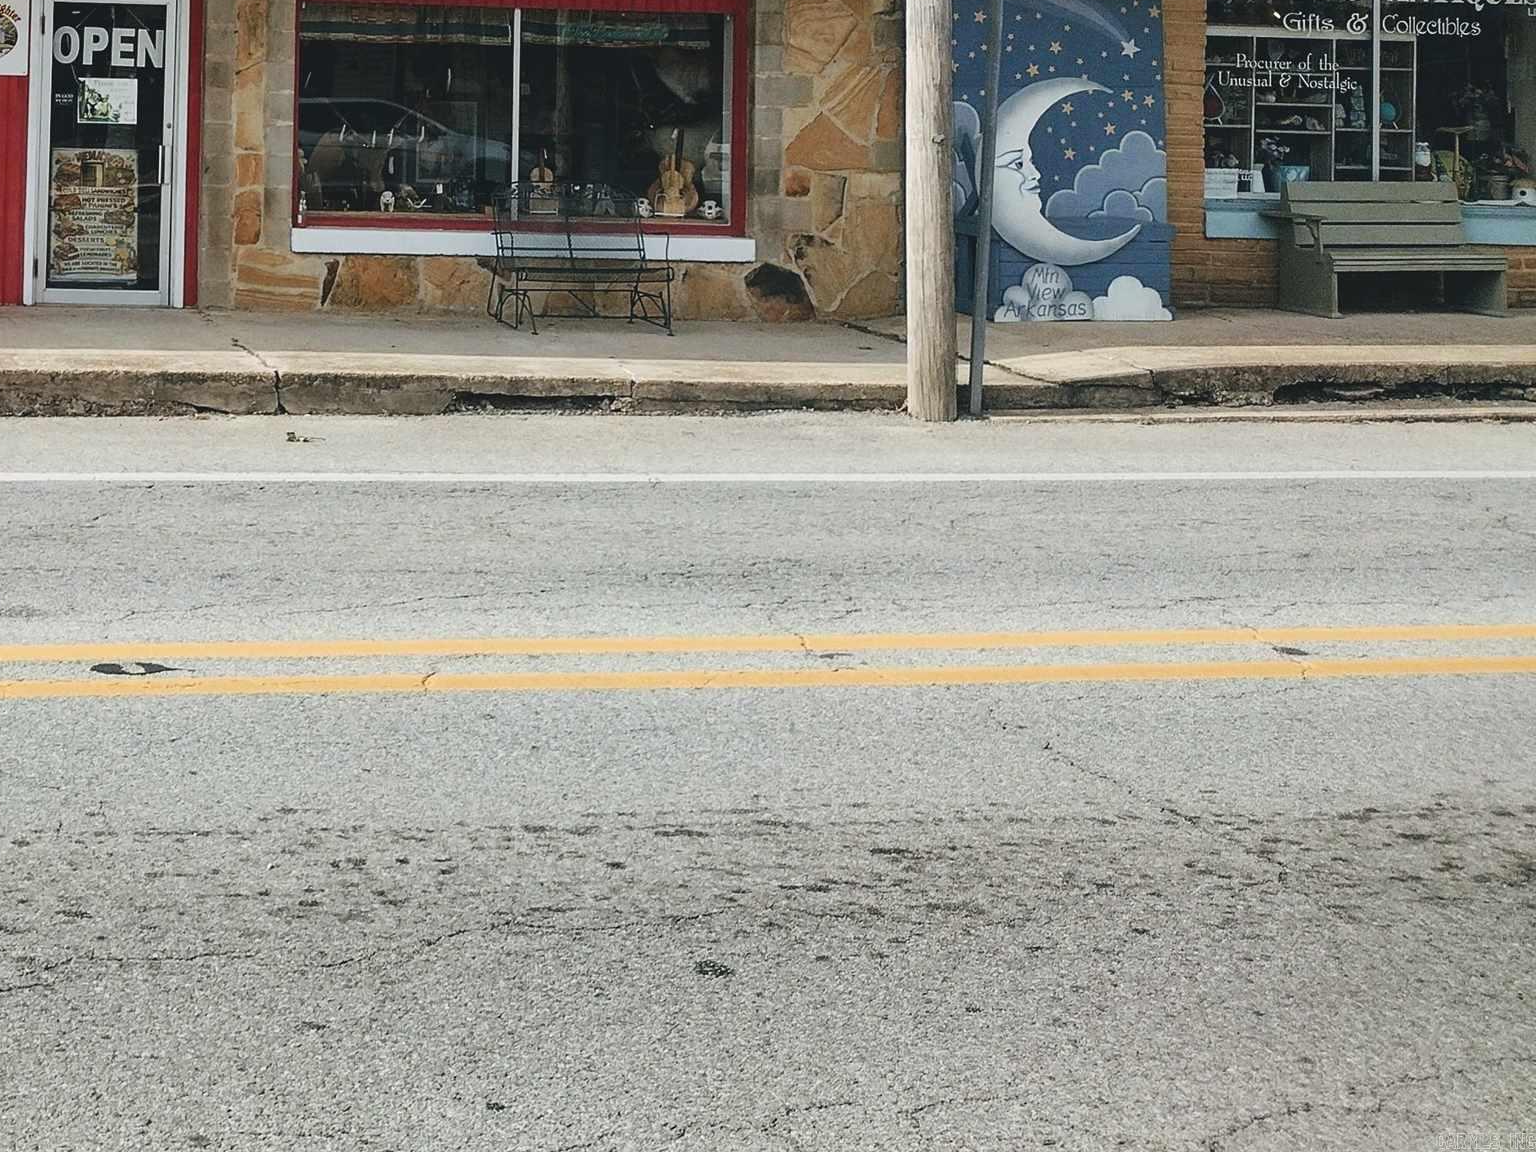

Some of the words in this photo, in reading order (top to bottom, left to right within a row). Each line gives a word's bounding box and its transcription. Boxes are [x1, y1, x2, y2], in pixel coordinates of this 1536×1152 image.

[1282, 11, 1335, 37] Gifts
[1346, 13, 1369, 35] &
[1382, 14, 1482, 37] Collectibles
[53, 25, 164, 68] OPEN
[1236, 53, 1292, 70] Procurer
[1298, 52, 1313, 71] of
[1319, 53, 1339, 72] the
[1218, 70, 1272, 87] Unusual
[1279, 72, 1291, 88] &
[1298, 72, 1358, 94] Nostalgic
[1031, 266, 1061, 284] Mtn
[1026, 283, 1066, 301] View
[1004, 300, 1087, 319] Arkansas
